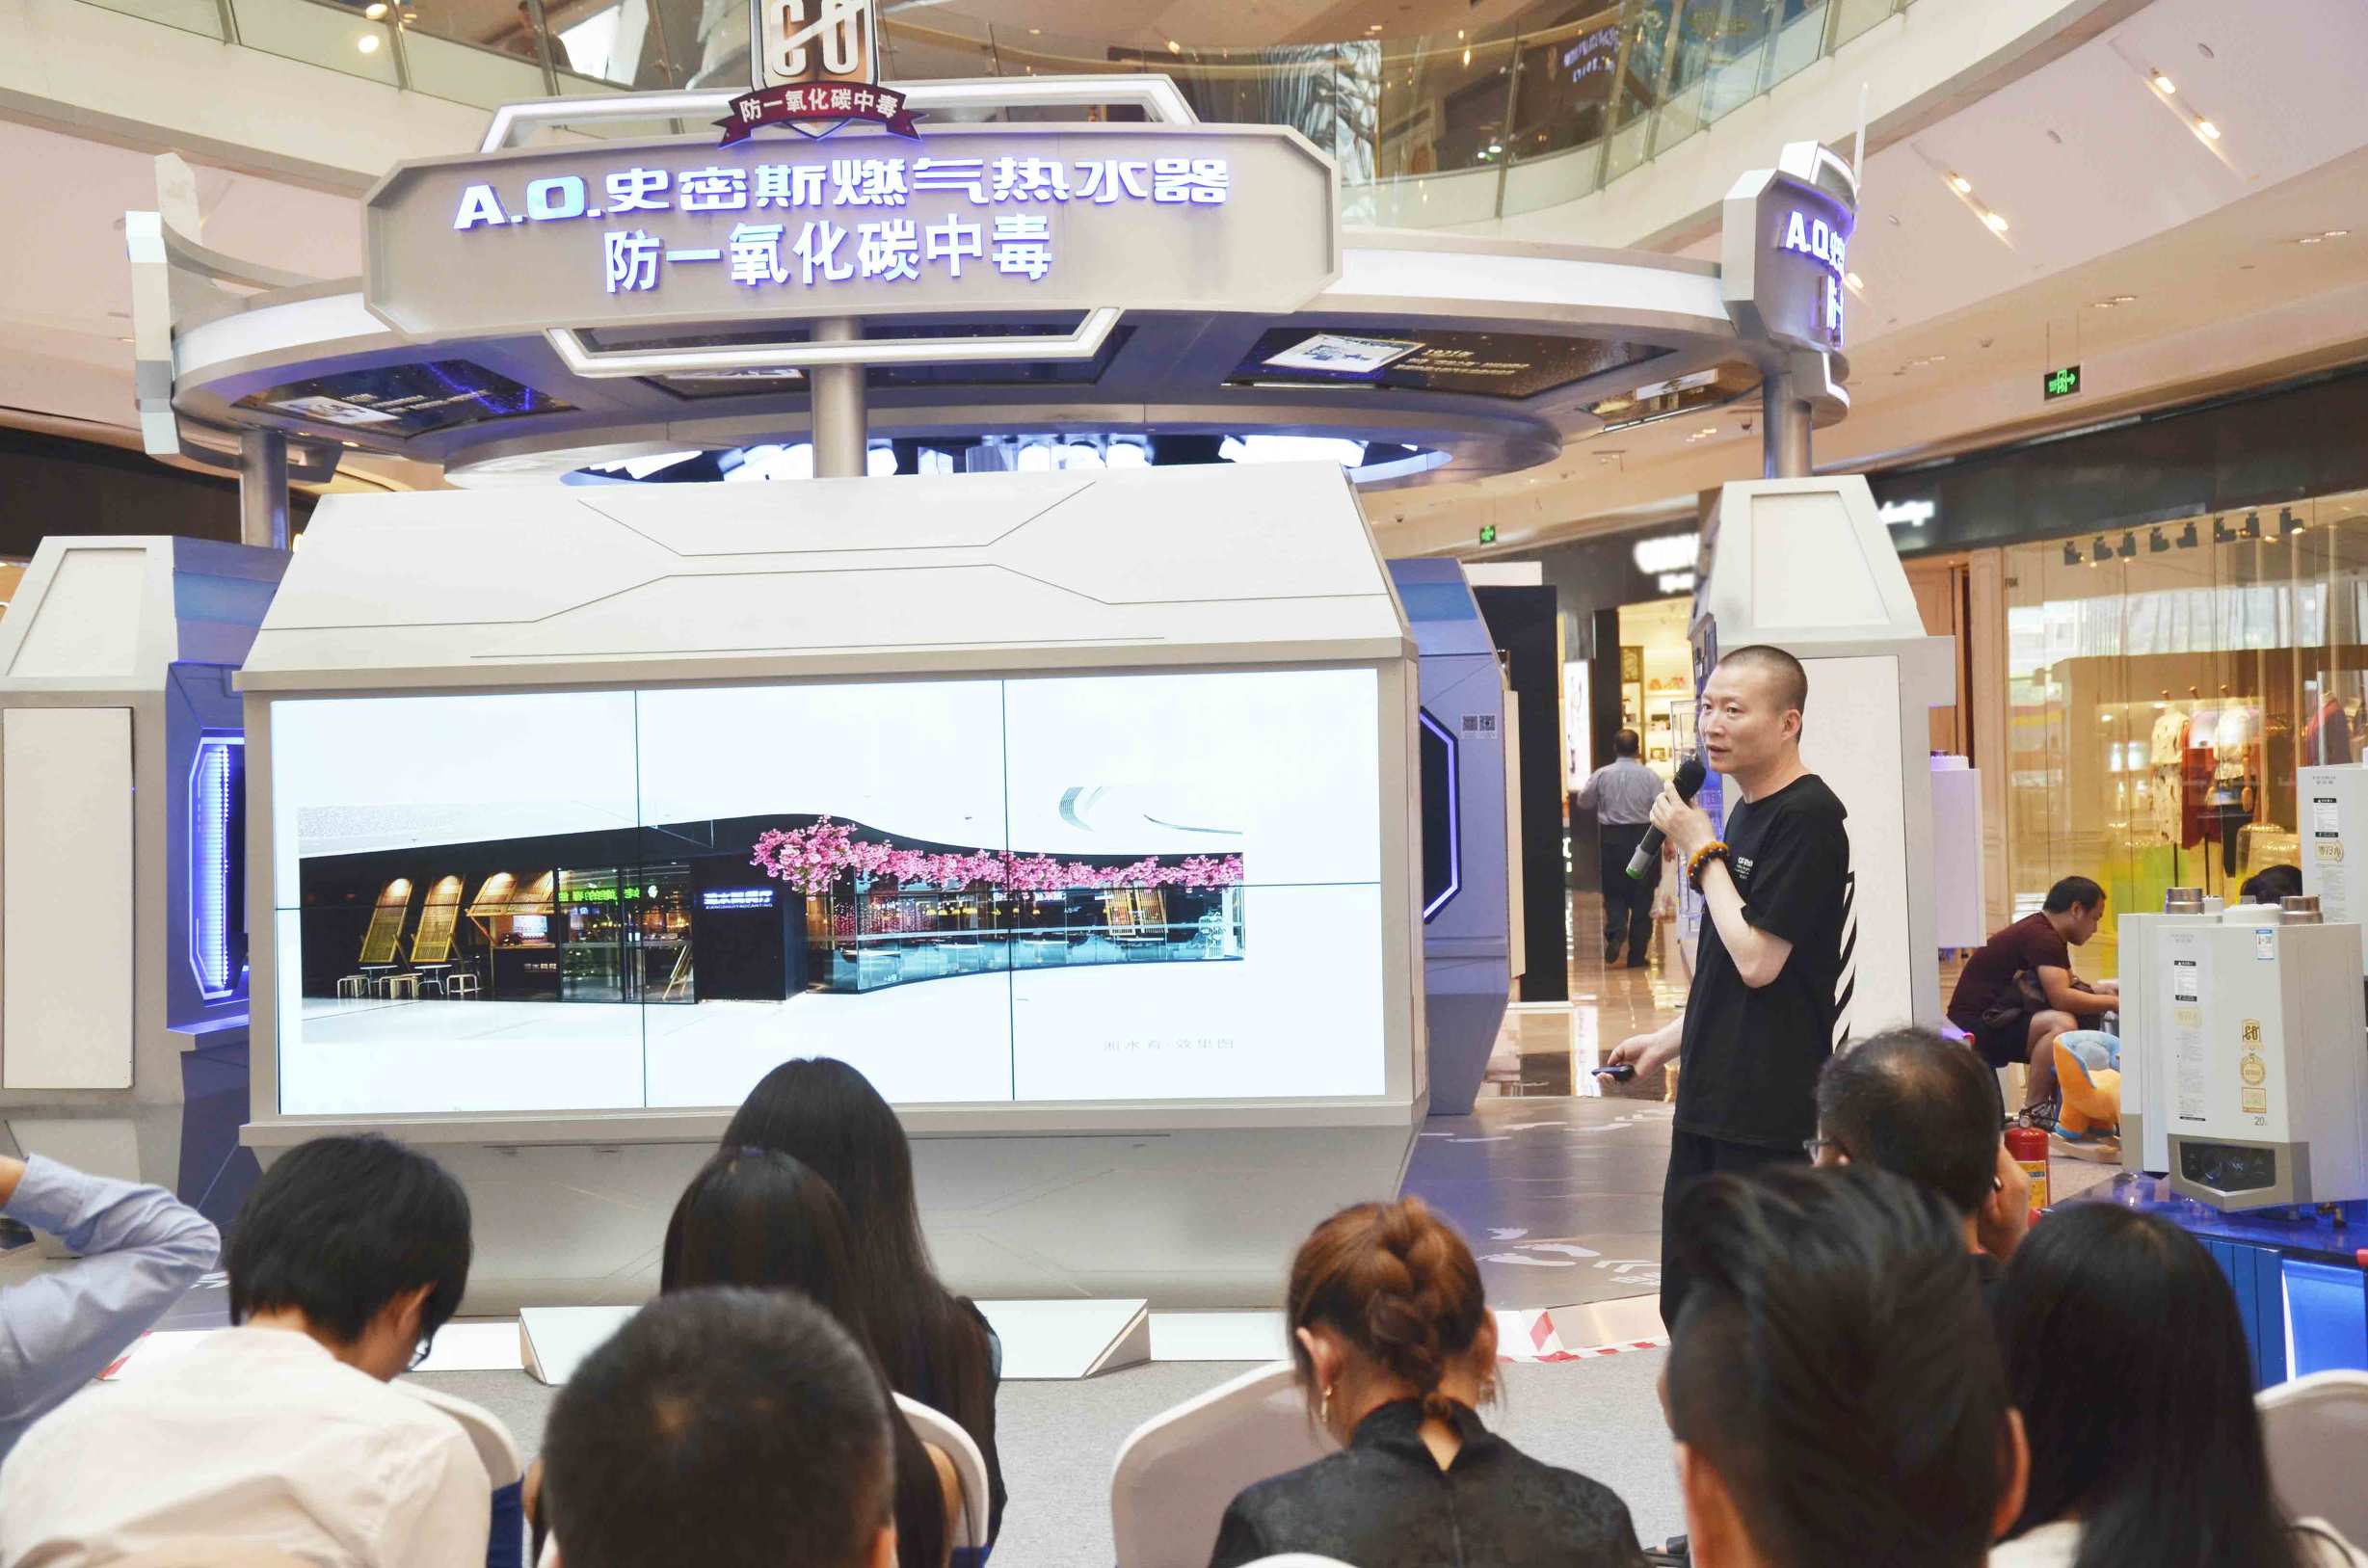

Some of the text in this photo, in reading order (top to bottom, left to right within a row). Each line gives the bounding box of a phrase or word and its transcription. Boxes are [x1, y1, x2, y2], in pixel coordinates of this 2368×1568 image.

[739, 88, 898, 123] 防一氧化碳中毒
[453, 156, 1229, 230] A.O.史密斯燃气热水器
[603, 213, 1053, 294] 防一氧化碳中毒
